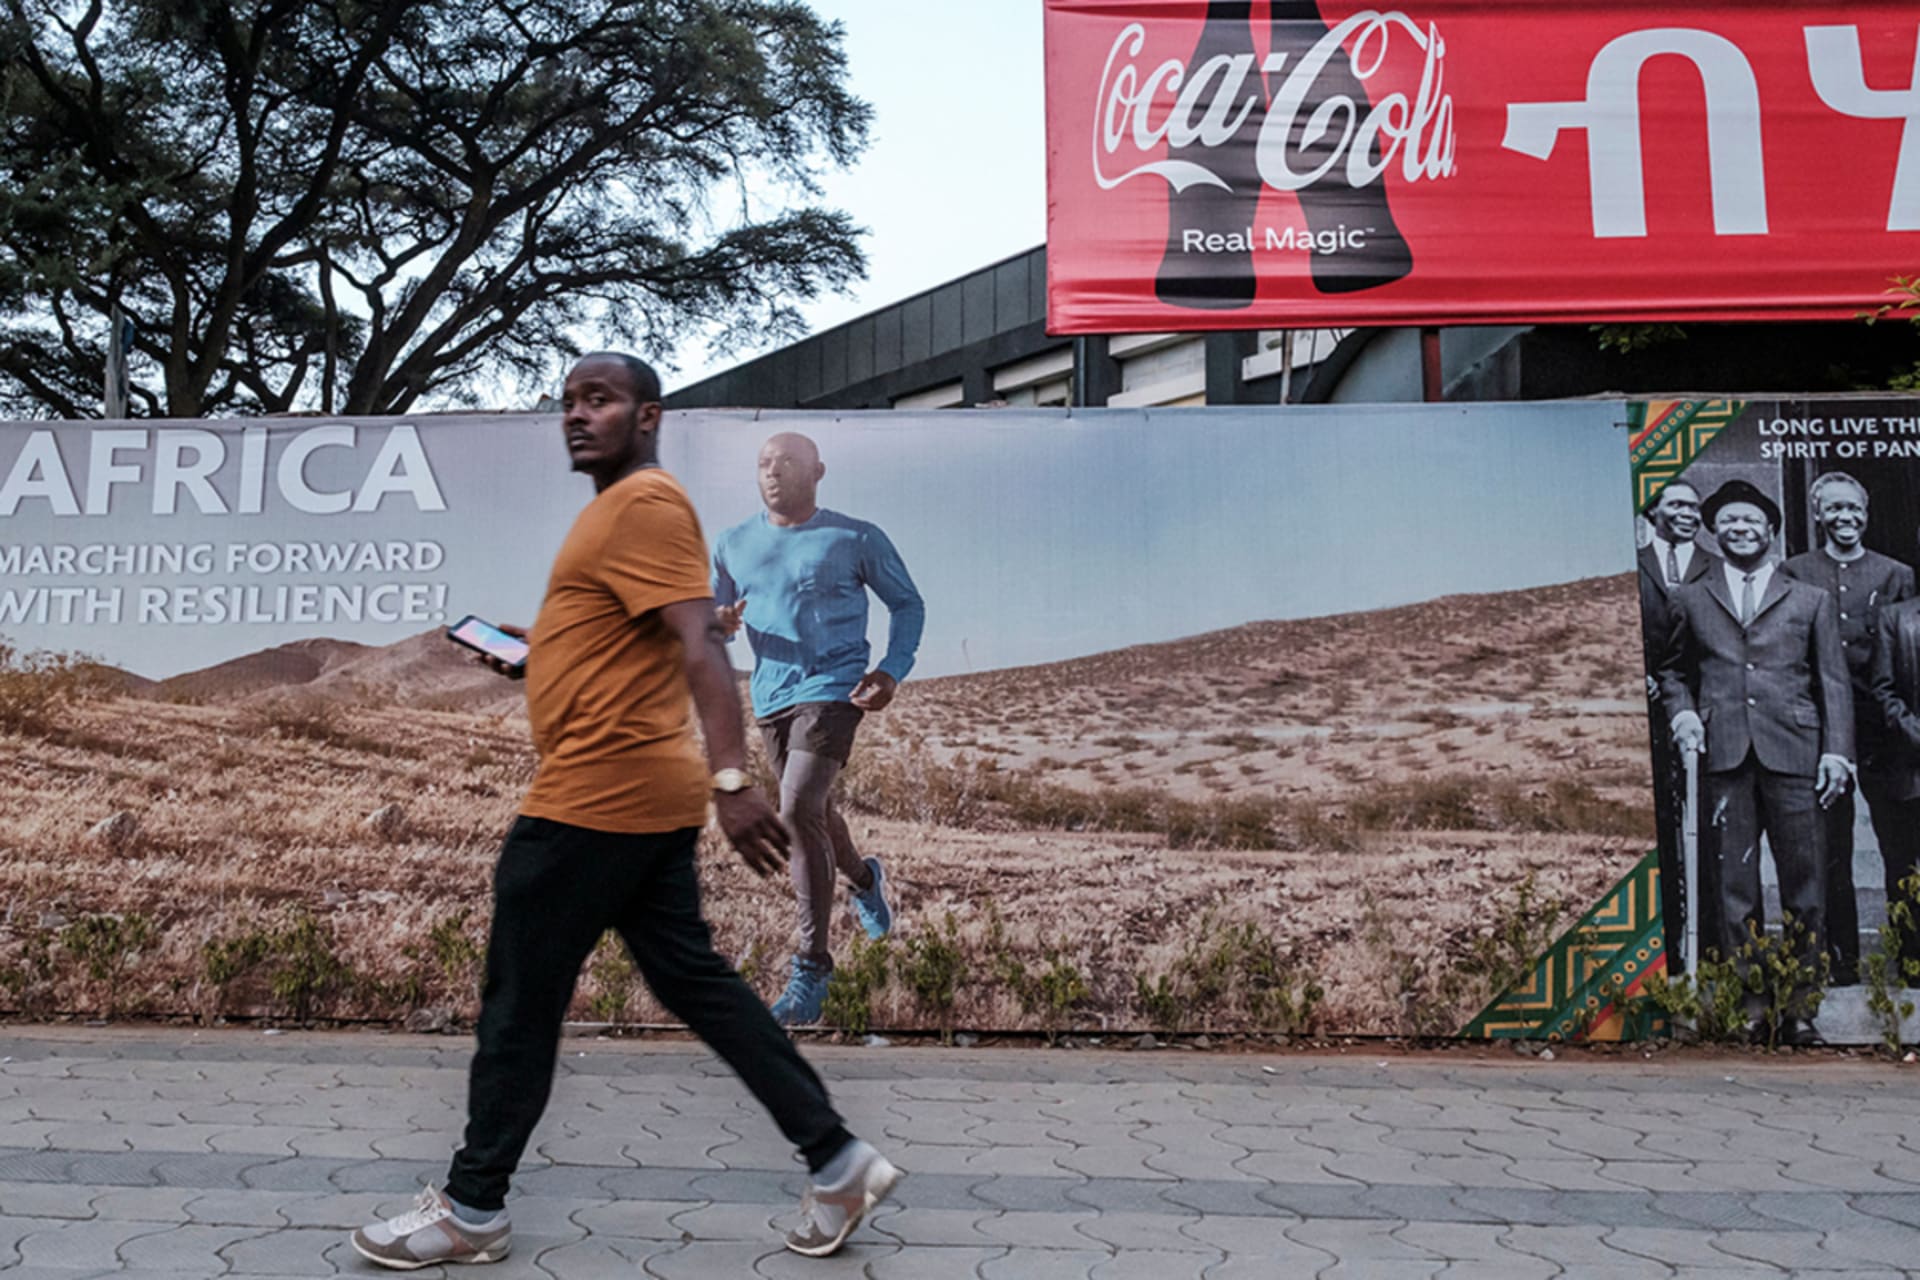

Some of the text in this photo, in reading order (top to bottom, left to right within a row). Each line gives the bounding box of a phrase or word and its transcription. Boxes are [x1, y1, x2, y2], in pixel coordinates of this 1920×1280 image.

[1093, 10, 1454, 194] Coca-Cola
[1182, 227, 1256, 253] Real
[1758, 418, 1825, 436] LONG
[1830, 418, 1879, 435] LIVE
[1760, 440, 1920, 459] SPIRIT OF PAN
[0, 424, 447, 516] AFRICA
[0, 540, 445, 575] MARCHING FORWARD
[0, 584, 448, 625] WITH RESILIENCE!
